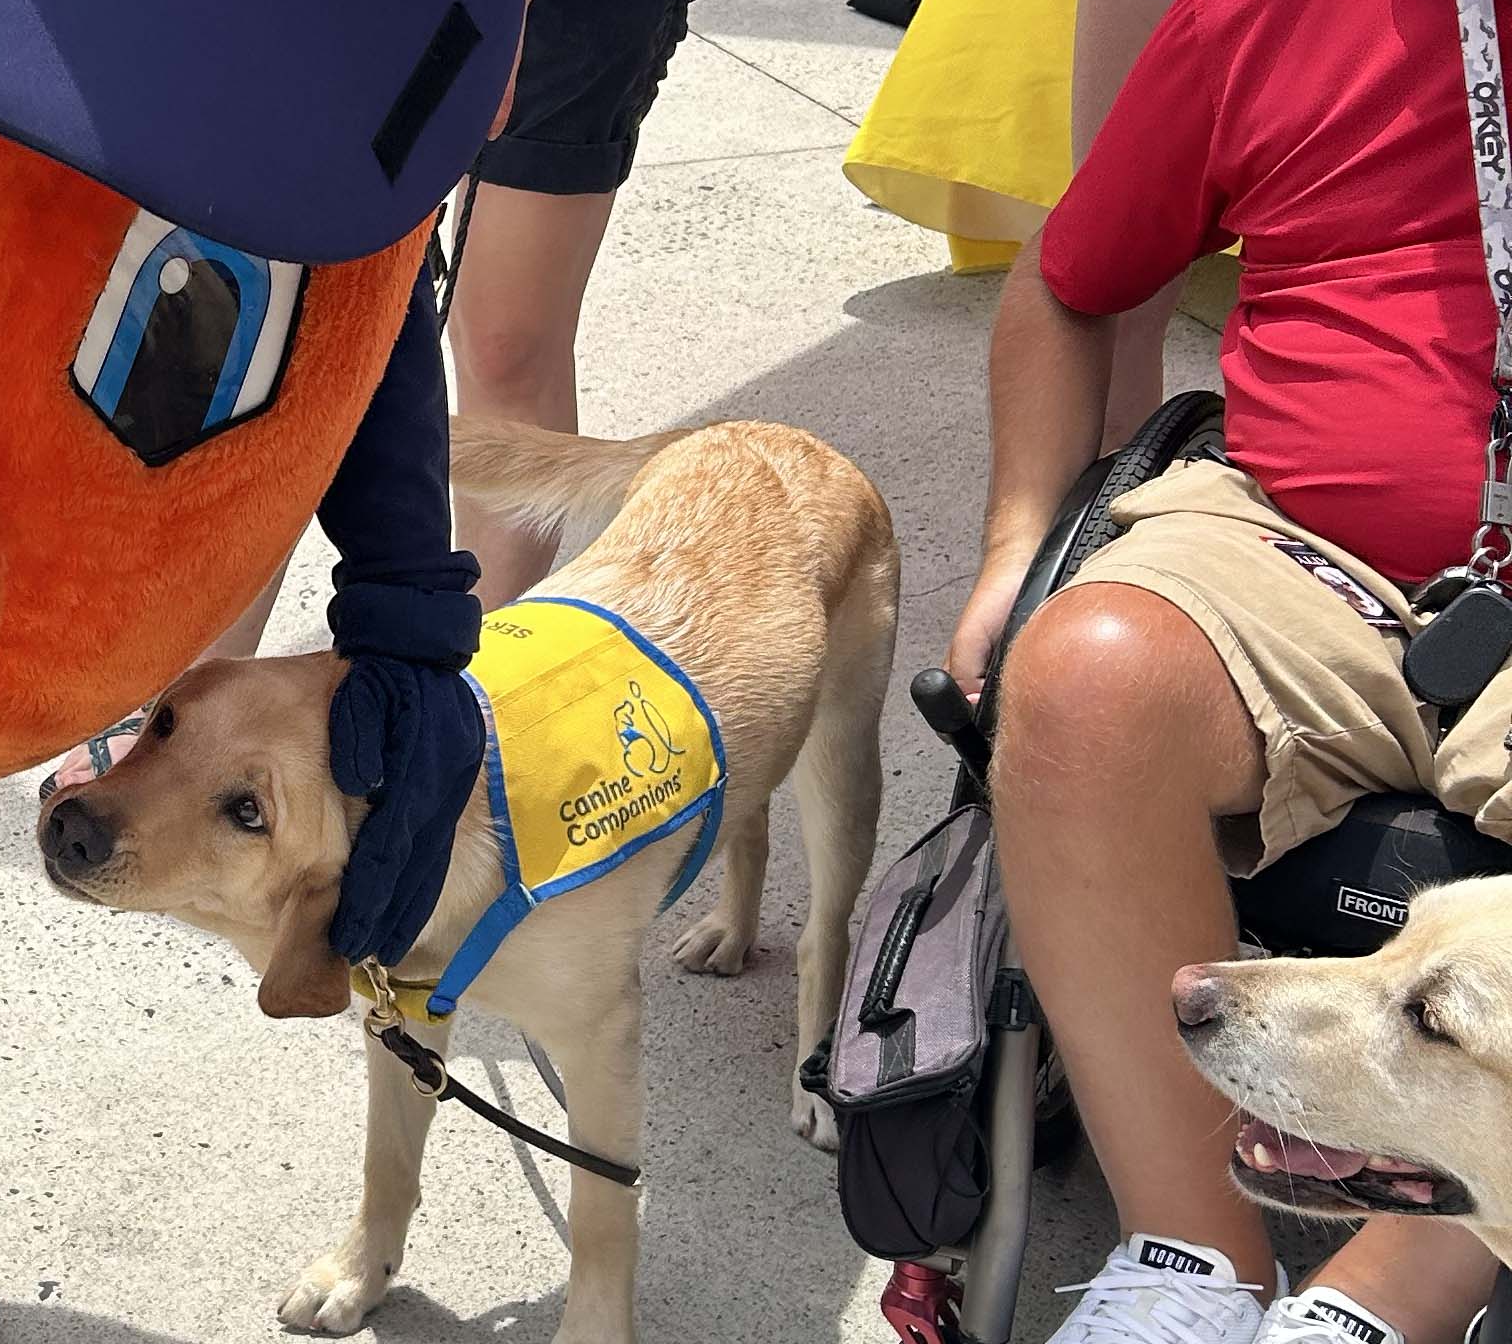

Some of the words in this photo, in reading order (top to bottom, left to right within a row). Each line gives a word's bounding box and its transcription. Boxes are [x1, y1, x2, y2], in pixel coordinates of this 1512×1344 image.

[1471, 81, 1506, 181] OAKLEY
[559, 775, 632, 823] Canine
[1344, 894, 1408, 922] FRONT
